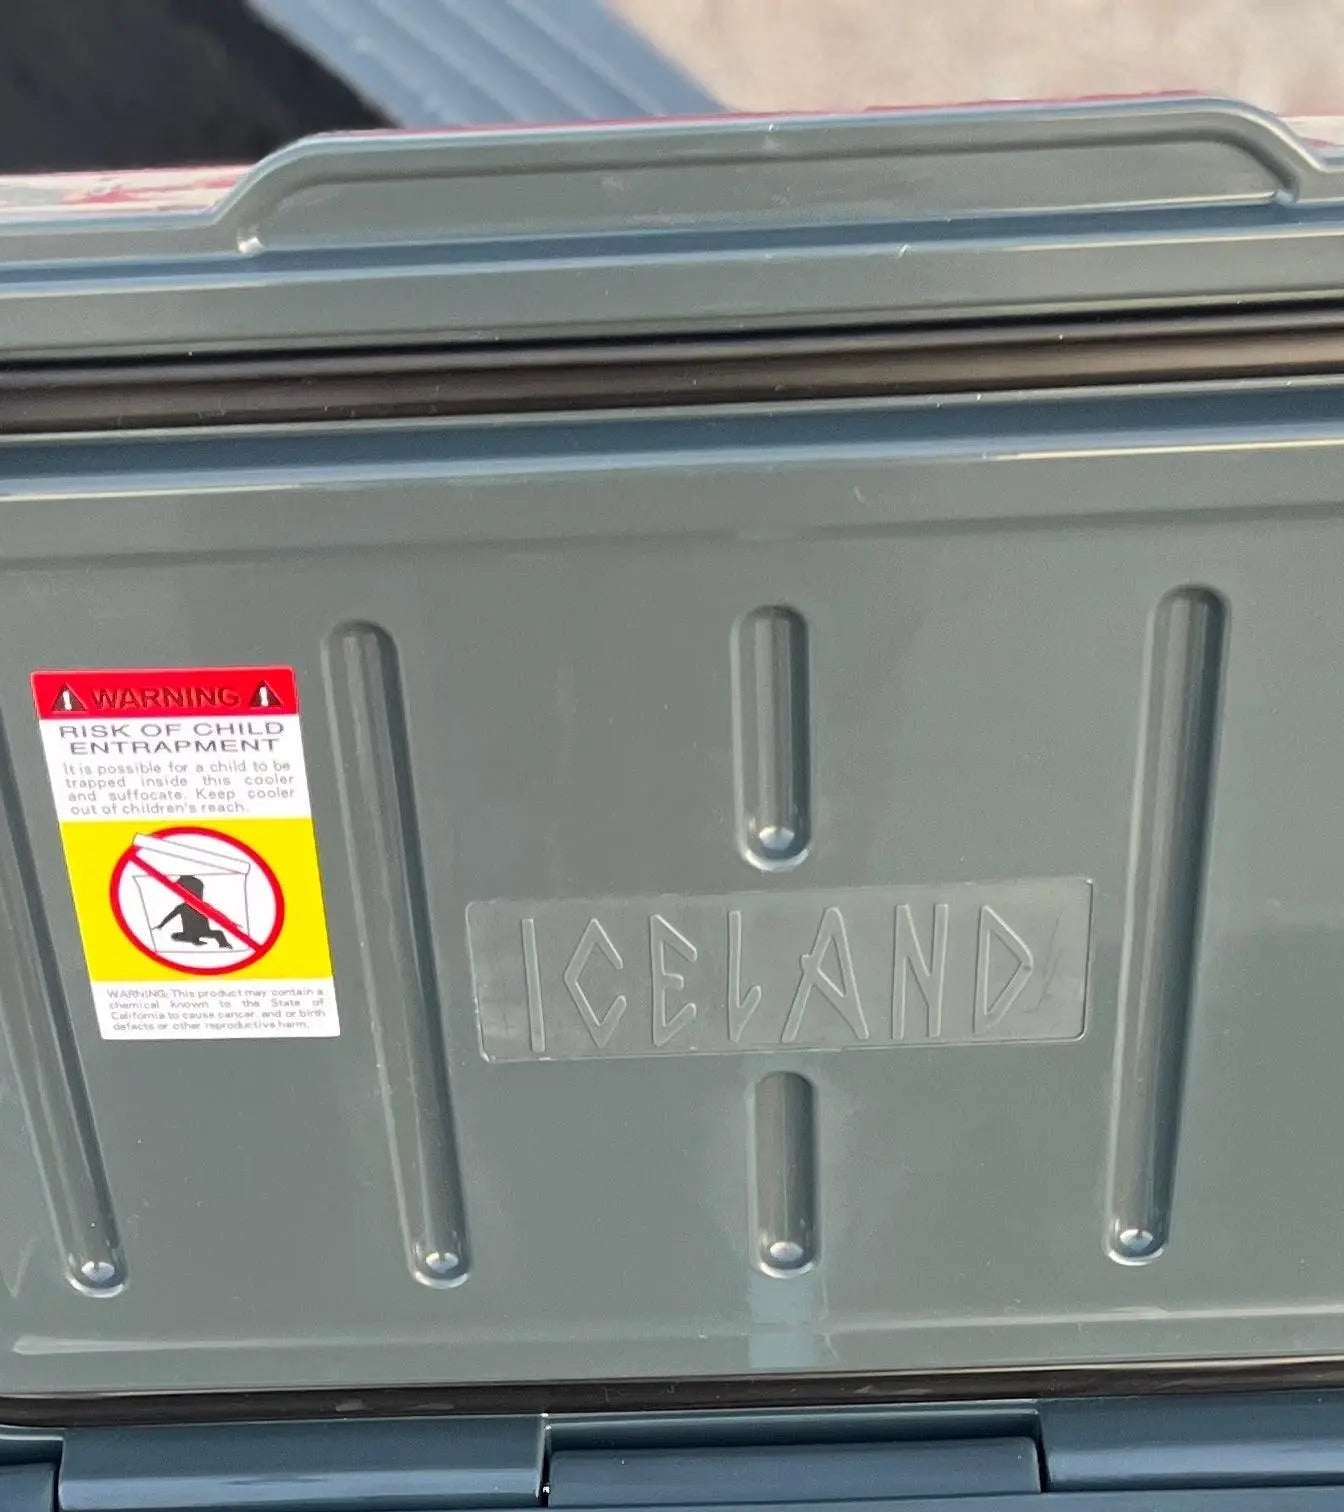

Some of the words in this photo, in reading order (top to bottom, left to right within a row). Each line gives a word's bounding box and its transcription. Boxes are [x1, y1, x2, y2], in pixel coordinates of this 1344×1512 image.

[90, 687, 241, 710] WARNING
[59, 724, 131, 738] RISK
[140, 723, 181, 737] OF
[193, 721, 284, 736] CHILD
[70, 738, 280, 755] ENTRAPMENT
[63, 763, 76, 775] It
[79, 763, 92, 775] is
[98, 762, 161, 776] possible
[169, 761, 189, 772] for
[196, 763, 204, 772] a
[210, 760, 246, 772] child
[253, 762, 268, 772] to
[273, 761, 291, 772] be
[66, 777, 126, 790] trapped
[141, 776, 188, 787] inside
[203, 775, 231, 786] this
[245, 774, 294, 785] cooler
[69, 790, 96, 801] and
[196, 788, 235, 802] Keep
[248, 787, 295, 799] cooler
[71, 804, 97, 816] out
[102, 803, 117, 815] of
[123, 802, 197, 815] children's
[522, 903, 1034, 1052] ICELAND
[172, 989, 195, 999] This
[197, 989, 242, 1000] product
[245, 989, 267, 999] may
[272, 988, 314, 997] contain
[317, 989, 324, 997] a
[110, 1001, 159, 1010] chemical
[171, 1000, 209, 1009] known
[219, 1000, 232, 1008] to
[242, 999, 260, 1008] the
[271, 998, 301, 1008] State
[313, 998, 324, 1007] of
[113, 1022, 155, 1031] defects
[173, 1021, 201, 1030] other
[205, 1020, 276, 1031] reproductive
